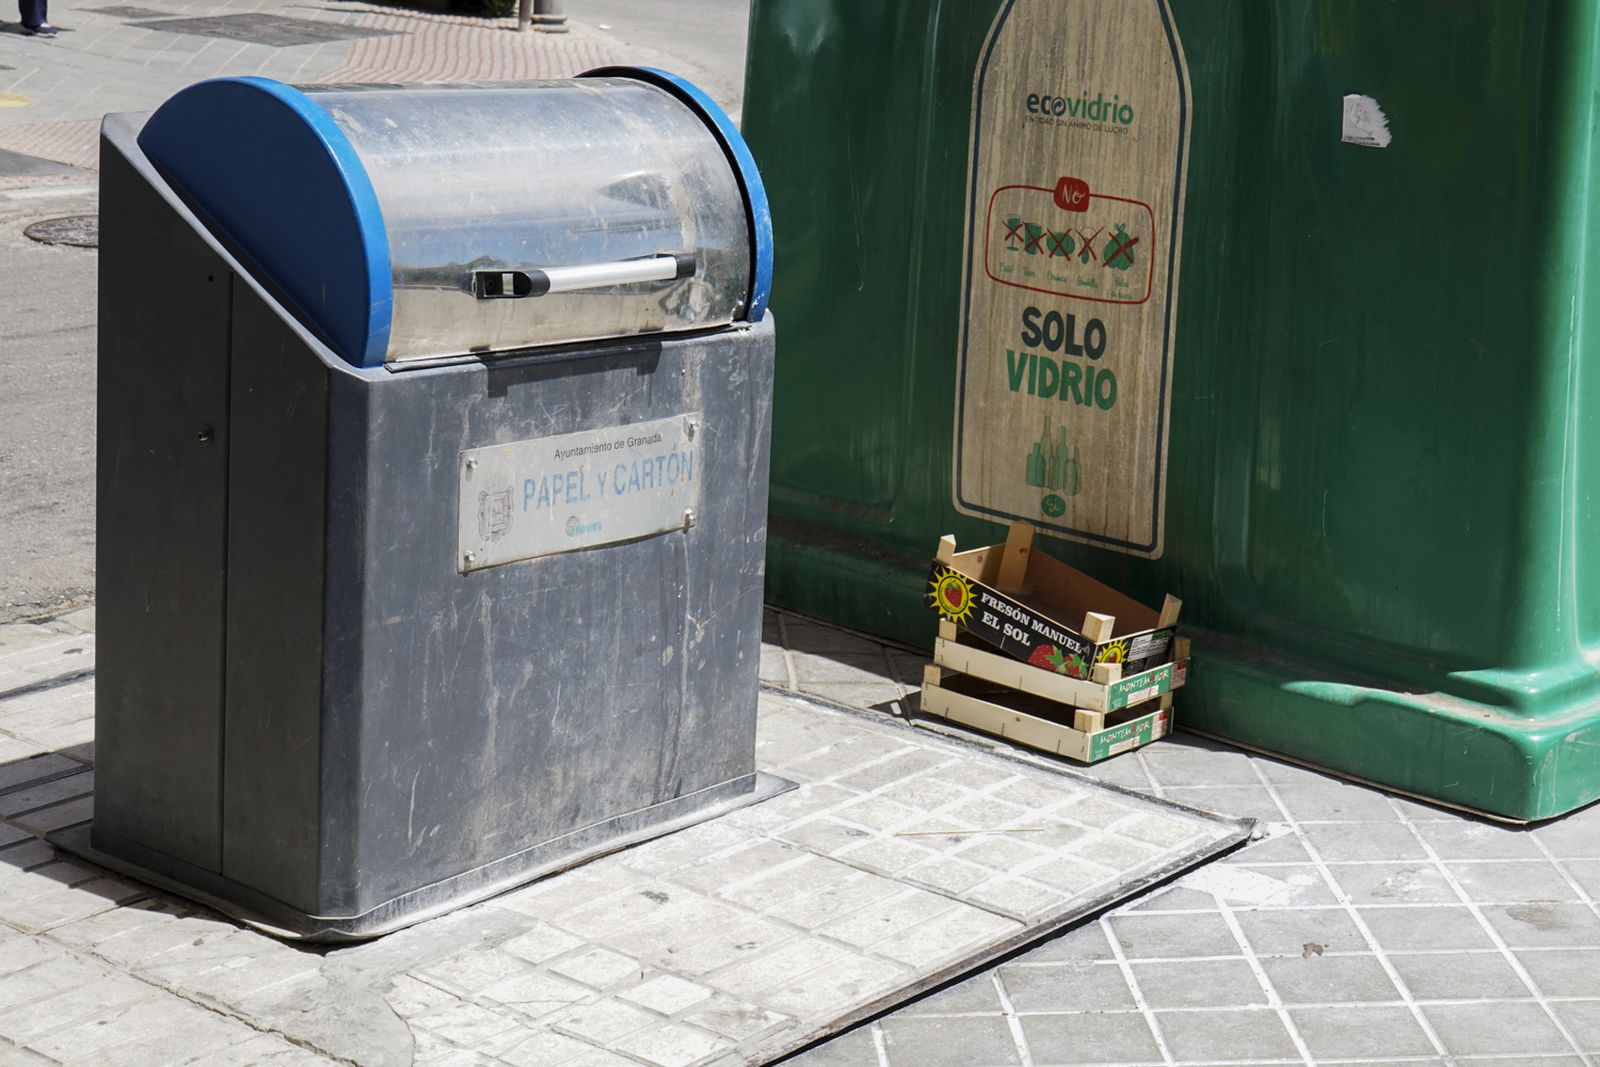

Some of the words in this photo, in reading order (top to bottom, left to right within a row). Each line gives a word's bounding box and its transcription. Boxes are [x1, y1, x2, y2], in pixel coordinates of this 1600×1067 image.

[1024, 115, 1055, 126] ENTIDAD
[1093, 124, 1103, 132] DE
[1104, 125, 1129, 135] LUCRO
[1026, 90, 1134, 125] ecovidrio
[1062, 184, 1085, 204] No
[1021, 306, 1107, 360] SOLO
[1006, 349, 1118, 411] VIDRIO
[554, 441, 613, 461] Ayuntamiento
[614, 439, 625, 450] de
[627, 432, 663, 448] Granada
[523, 467, 591, 512] PAPEL
[597, 471, 608, 498] Y
[613, 444, 695, 496] CARTÓN
[980, 592, 1030, 627] FRESÓN
[1031, 620, 1083, 654] MANUEL
[981, 611, 1000, 631] EL
[1002, 622, 1031, 647] SOL
